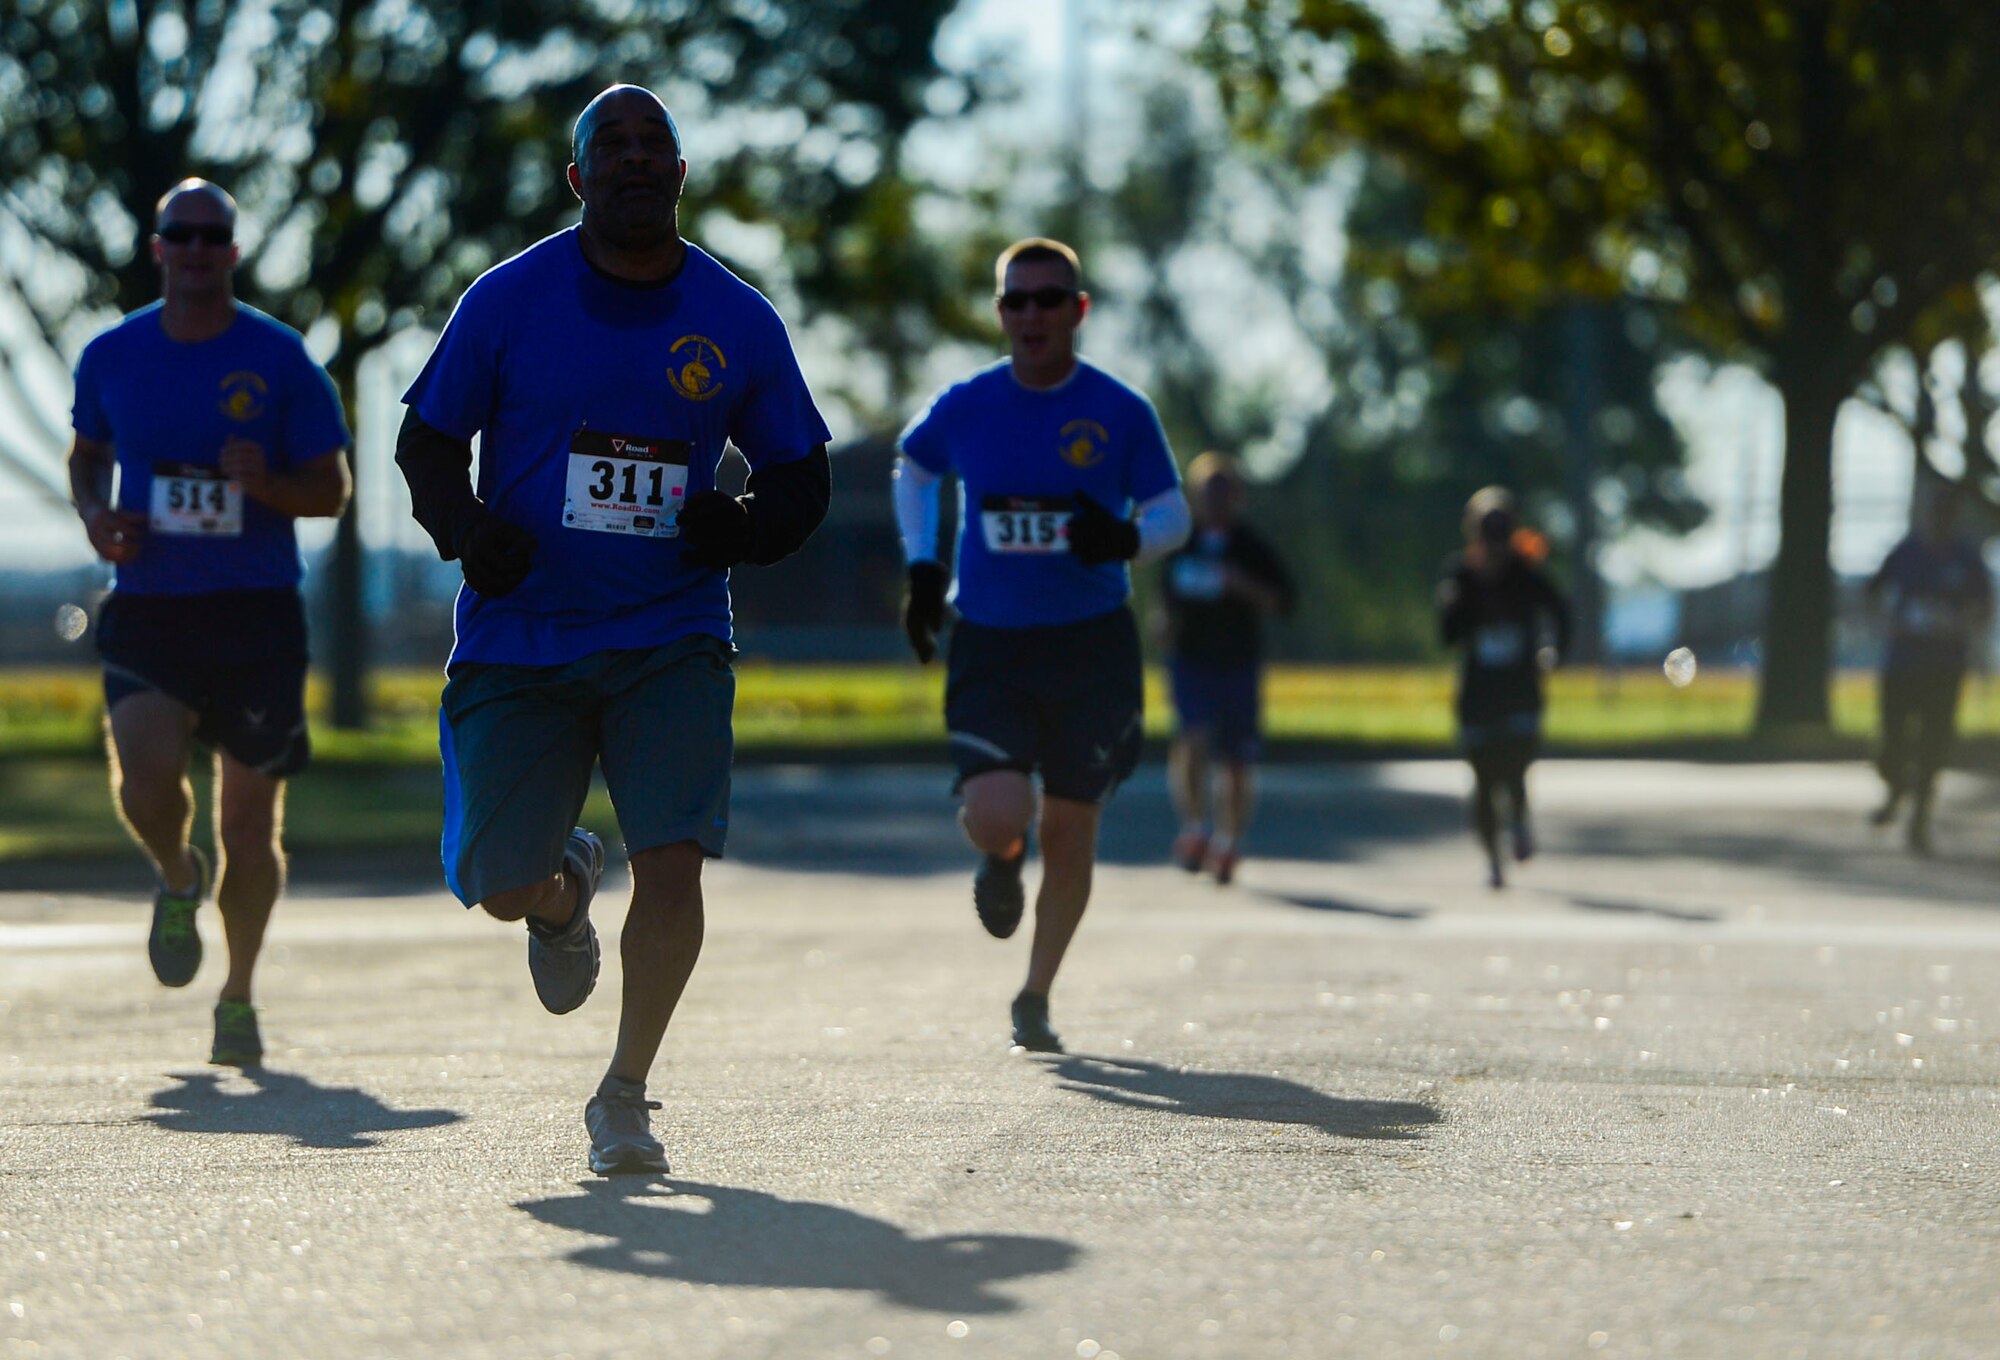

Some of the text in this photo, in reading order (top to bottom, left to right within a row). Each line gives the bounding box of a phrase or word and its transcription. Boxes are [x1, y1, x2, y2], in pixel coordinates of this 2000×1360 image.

[168, 480, 225, 512] 514
[589, 461, 664, 505] 311
[591, 502, 660, 514] www.RoadID.com
[998, 513, 1056, 543] 315
